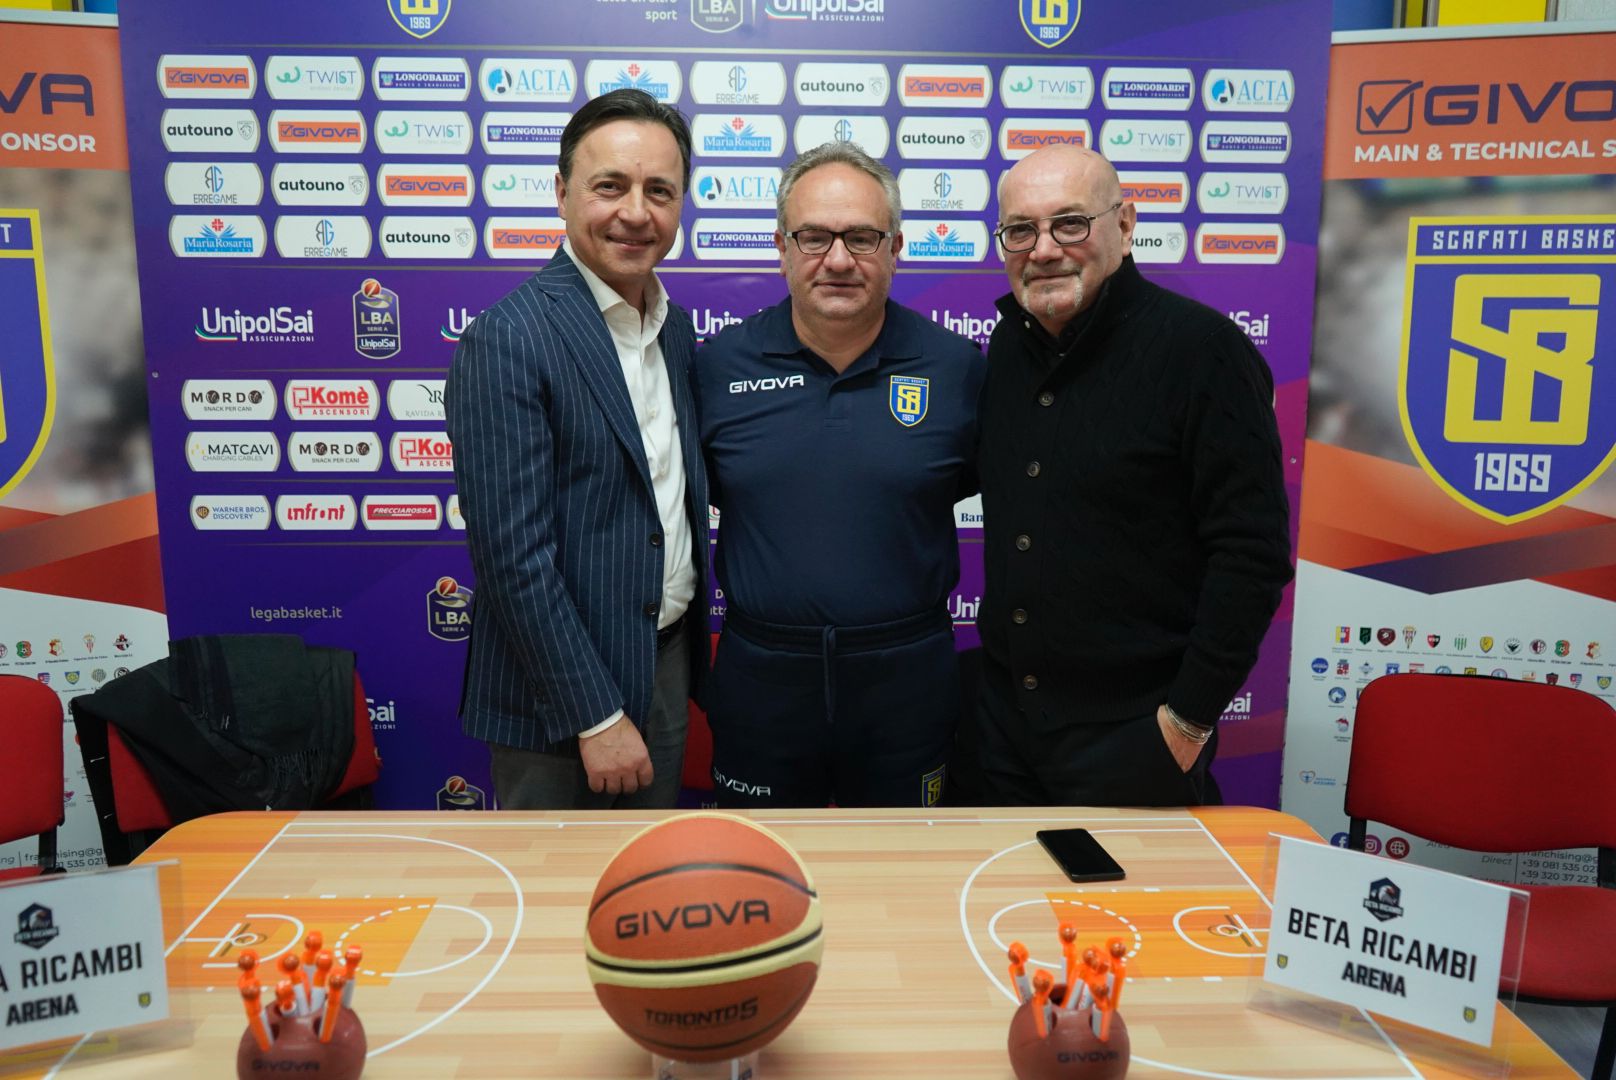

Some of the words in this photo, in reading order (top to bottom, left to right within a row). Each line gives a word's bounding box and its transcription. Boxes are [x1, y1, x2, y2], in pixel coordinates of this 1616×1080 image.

[409, 16, 431, 29] 1969
[646, 10, 678, 23] sport
[1040, 26, 1059, 40] 1969
[180, 74, 246, 84] GIVOVA
[305, 70, 356, 84] TWIST
[395, 74, 460, 82] LONGOBARDI
[515, 69, 572, 91] ACTA
[800, 81, 866, 92] autouno
[918, 82, 982, 92] GIVOVA
[1038, 80, 1086, 94] TWIST
[1124, 84, 1185, 92] LONGOBARDI
[1238, 80, 1290, 101] ACTA
[716, 94, 759, 104] ERREGAME
[167, 125, 234, 136] autouno
[292, 127, 358, 137] GIVOVA
[414, 124, 464, 138] TWIST
[902, 133, 965, 145] autouno
[1138, 133, 1185, 146] TWIST
[1222, 136, 1282, 145] LONGOBARDI
[1354, 144, 1419, 163] MAIN
[1426, 144, 1442, 160] &
[1450, 139, 1595, 161] TECHNICAL
[279, 180, 344, 191] autouno
[400, 181, 465, 191] GIVOVA
[726, 176, 778, 198] ACTA
[193, 193, 237, 204] ERREGAME
[1235, 186, 1282, 200] TWIST
[921, 200, 963, 209] ERREGAME
[385, 232, 450, 244] autouno
[1432, 230, 1526, 250] SCAFATI
[1217, 240, 1278, 250] GIVOVA
[304, 247, 348, 257] ERREGAME
[202, 306, 314, 342] UnipolSai
[360, 312, 394, 325] LBA
[360, 338, 396, 349] UnipolSai
[729, 374, 804, 394] GIVOVA
[192, 390, 262, 404] MORDO
[311, 386, 368, 404] Komè
[208, 444, 274, 455] MATCAVI
[300, 442, 370, 456] MORDO
[1474, 452, 1552, 493] 1969
[251, 606, 342, 622] legabasket.it
[435, 612, 472, 625] LBA
[1481, 855, 1512, 865] Direct
[1542, 860, 1559, 869] 081
[1562, 862, 1580, 871] 535
[1521, 870, 1538, 879] +39
[1540, 871, 1559, 880] 320
[1562, 873, 1574, 881] 37
[616, 900, 771, 940] GIVOVA
[1288, 908, 1350, 949] BETA
[1361, 926, 1477, 983] RICAMBI
[21, 942, 142, 989] RICAMBI
[1342, 961, 1407, 998] ARENA
[6, 994, 79, 1026] ARENA
